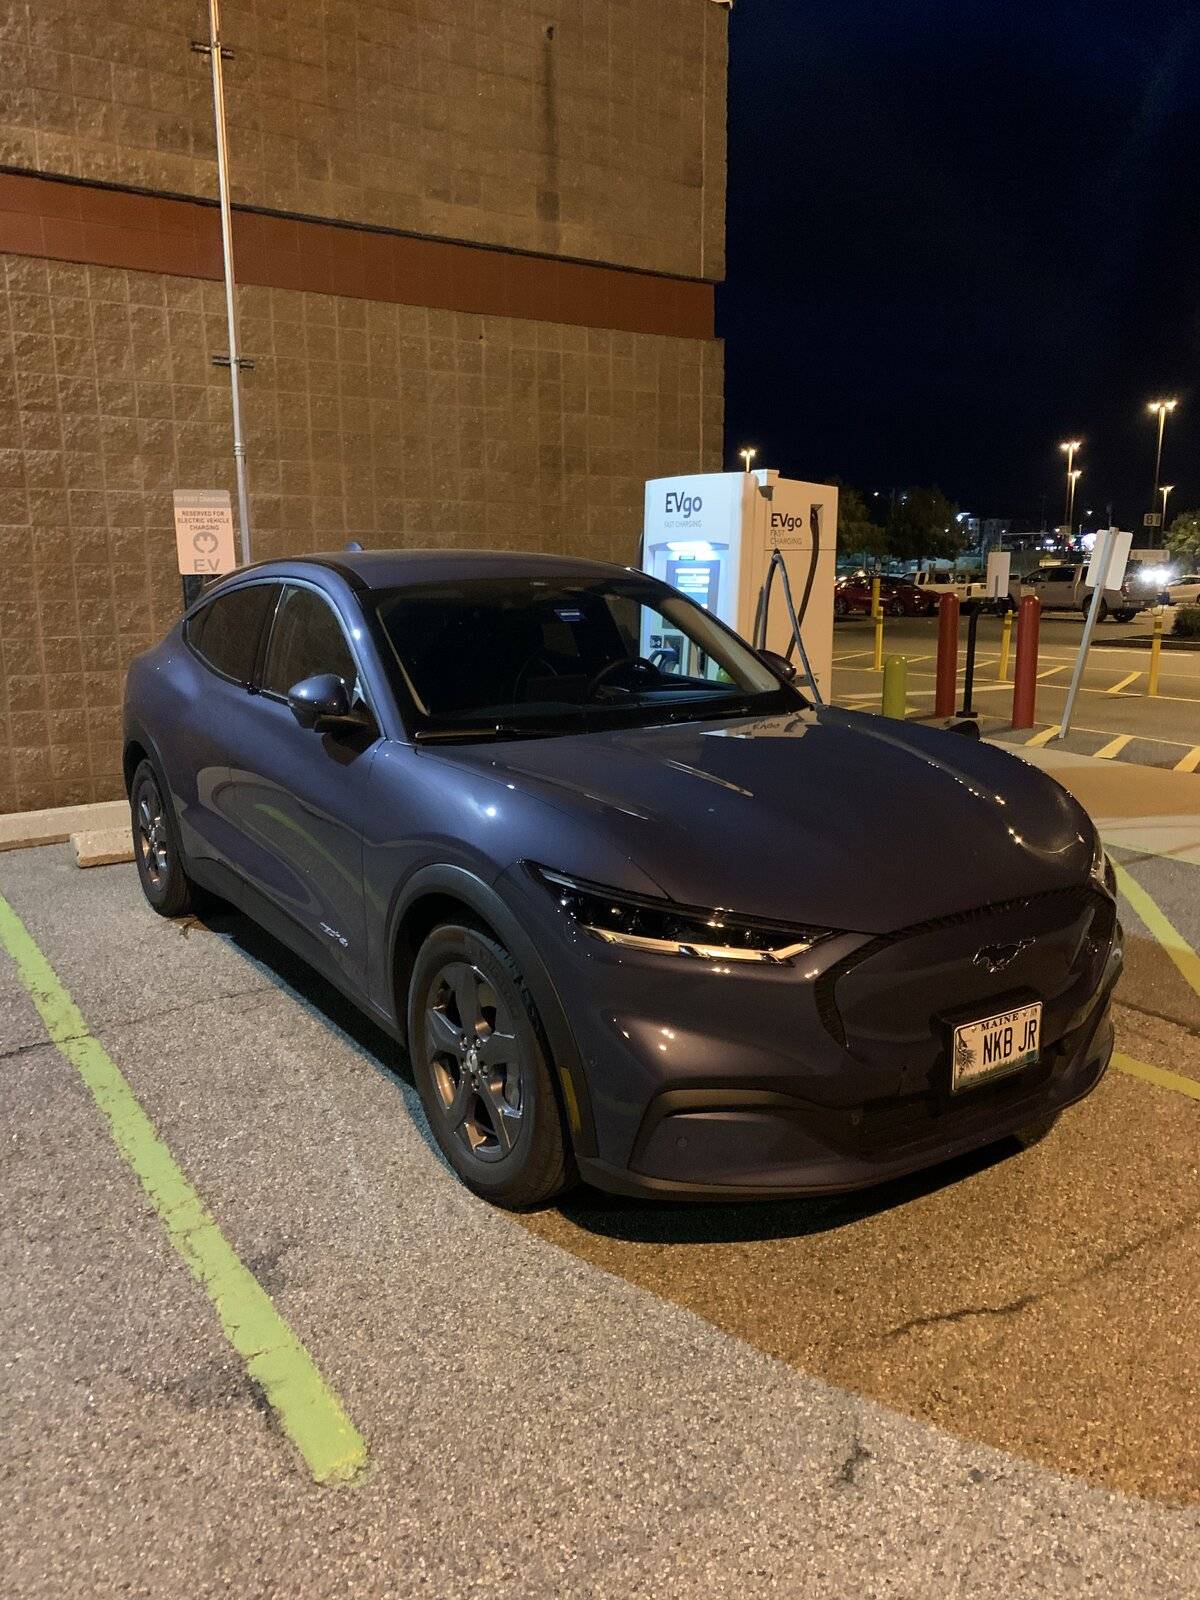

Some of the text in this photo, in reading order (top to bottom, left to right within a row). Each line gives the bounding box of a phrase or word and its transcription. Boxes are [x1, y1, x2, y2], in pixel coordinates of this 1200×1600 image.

[665, 491, 703, 518] EVgo
[771, 513, 802, 531] EVgo
[194, 559, 220, 572] EV
[981, 1013, 1019, 1031] MAINE
[983, 1019, 1037, 1065] NKB JR
